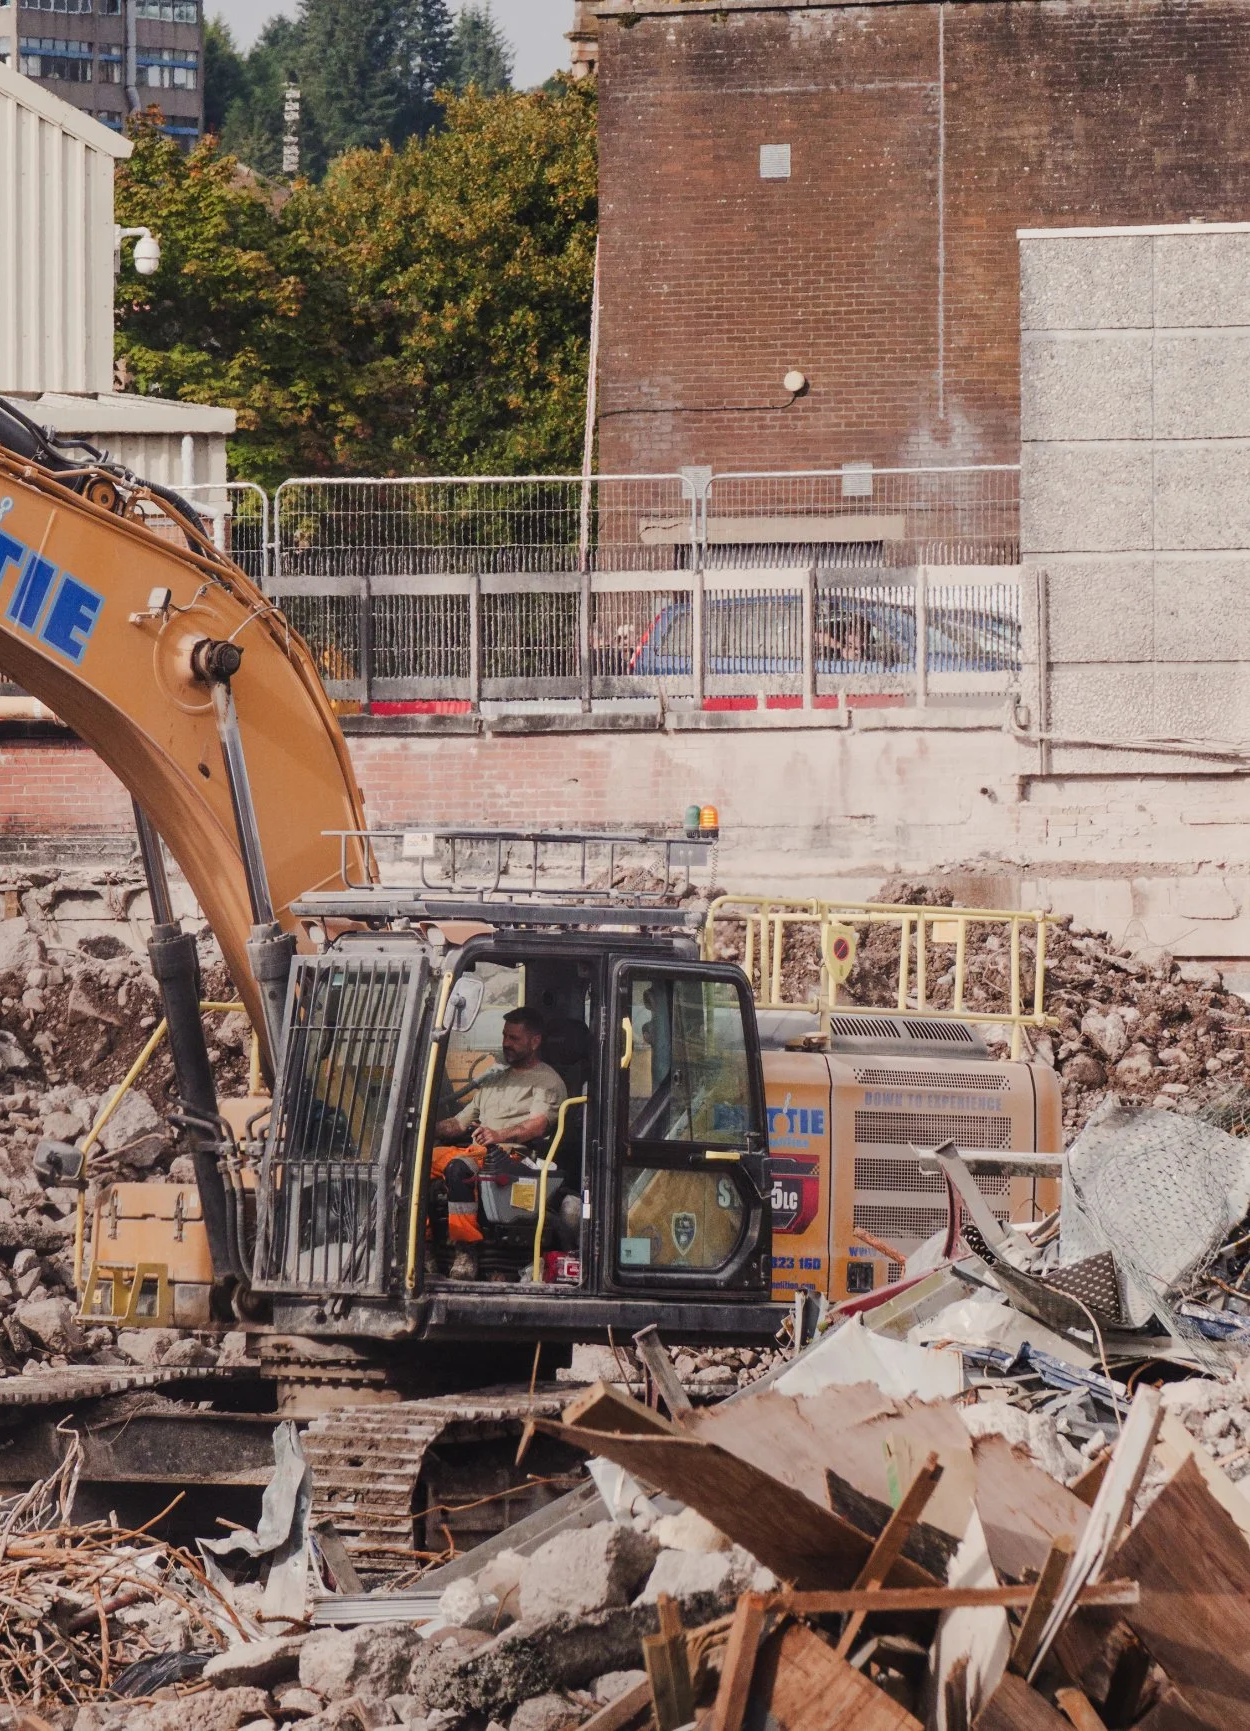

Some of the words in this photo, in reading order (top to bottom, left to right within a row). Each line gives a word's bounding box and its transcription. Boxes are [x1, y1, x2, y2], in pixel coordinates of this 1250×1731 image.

[864, 1091, 903, 1107] DOWN
[907, 1093, 923, 1108] TO
[926, 1094, 1002, 1112] EXPERIENCE
[770, 1181, 798, 1210] 5LC
